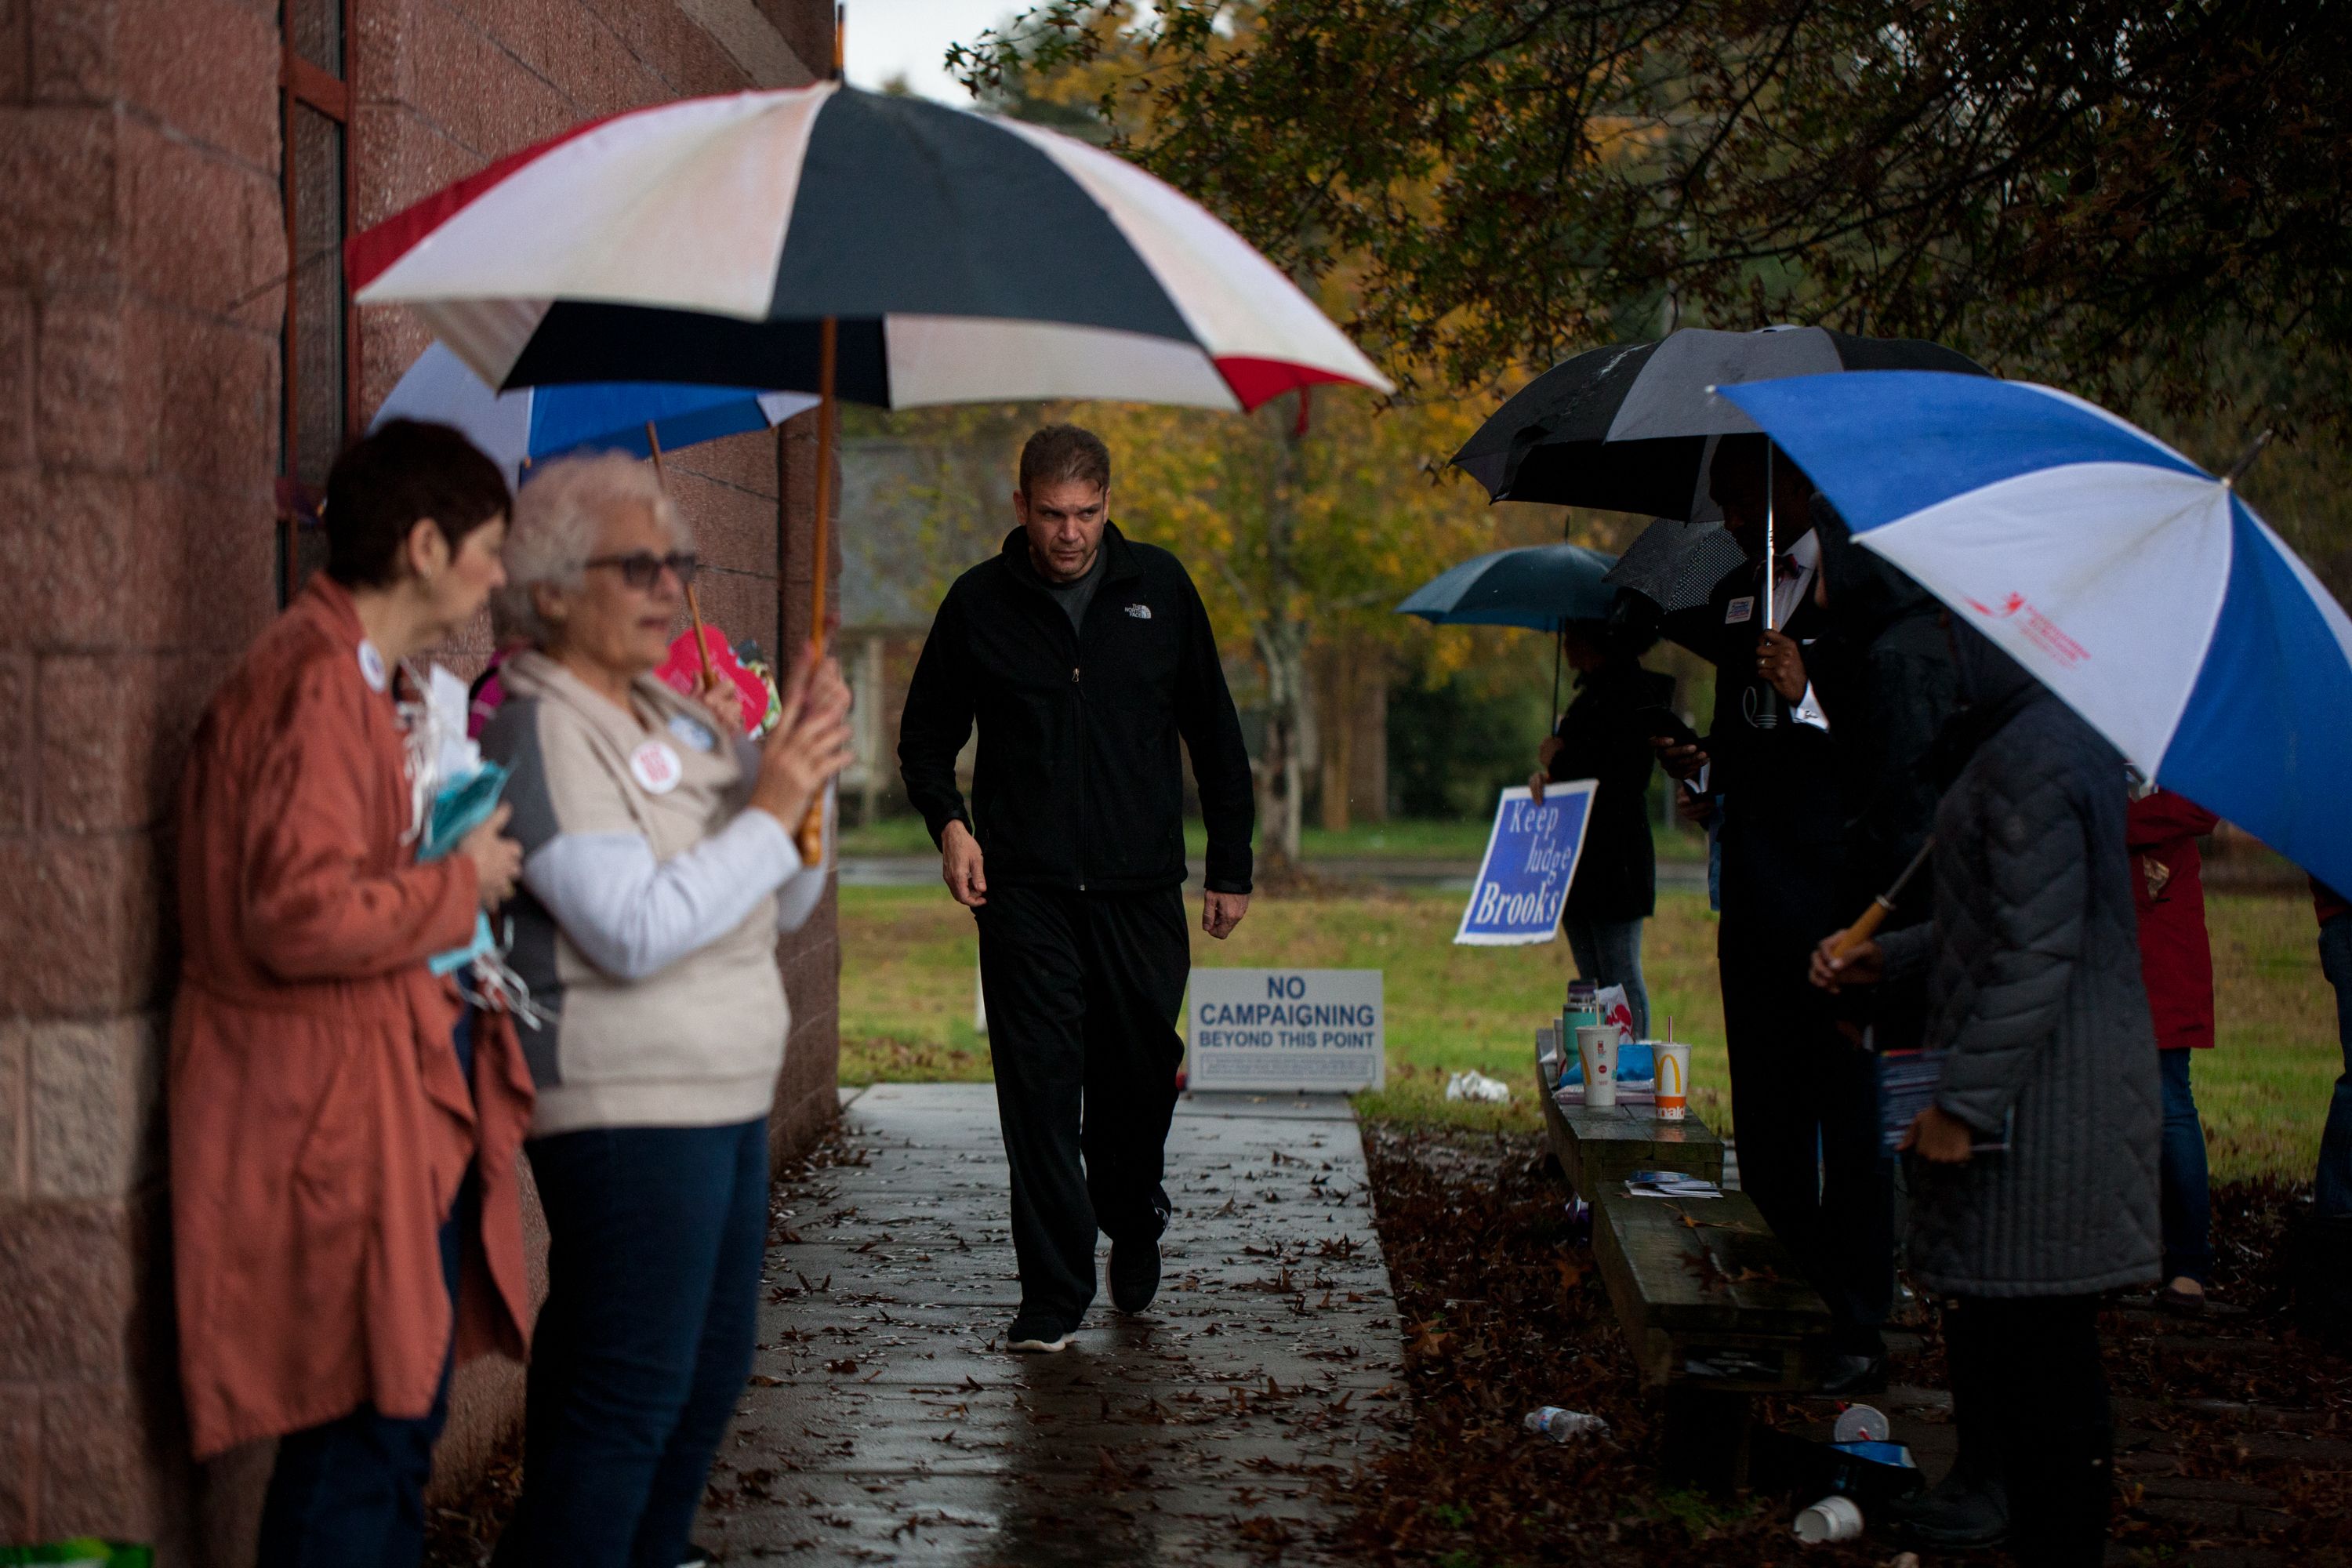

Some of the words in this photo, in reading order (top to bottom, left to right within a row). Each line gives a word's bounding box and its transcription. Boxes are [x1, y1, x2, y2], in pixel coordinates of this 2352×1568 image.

[1509, 800, 1559, 840] Keep
[1525, 833, 1571, 885] Judge
[1475, 881, 1560, 925] Brooks
[1268, 977, 1305, 999] NO
[1200, 1004, 1374, 1026] CAMPAIGNING
[1199, 1030, 1272, 1047] BEYOND
[1279, 1031, 1317, 1048] THIS
[1323, 1031, 1375, 1049] POINT
